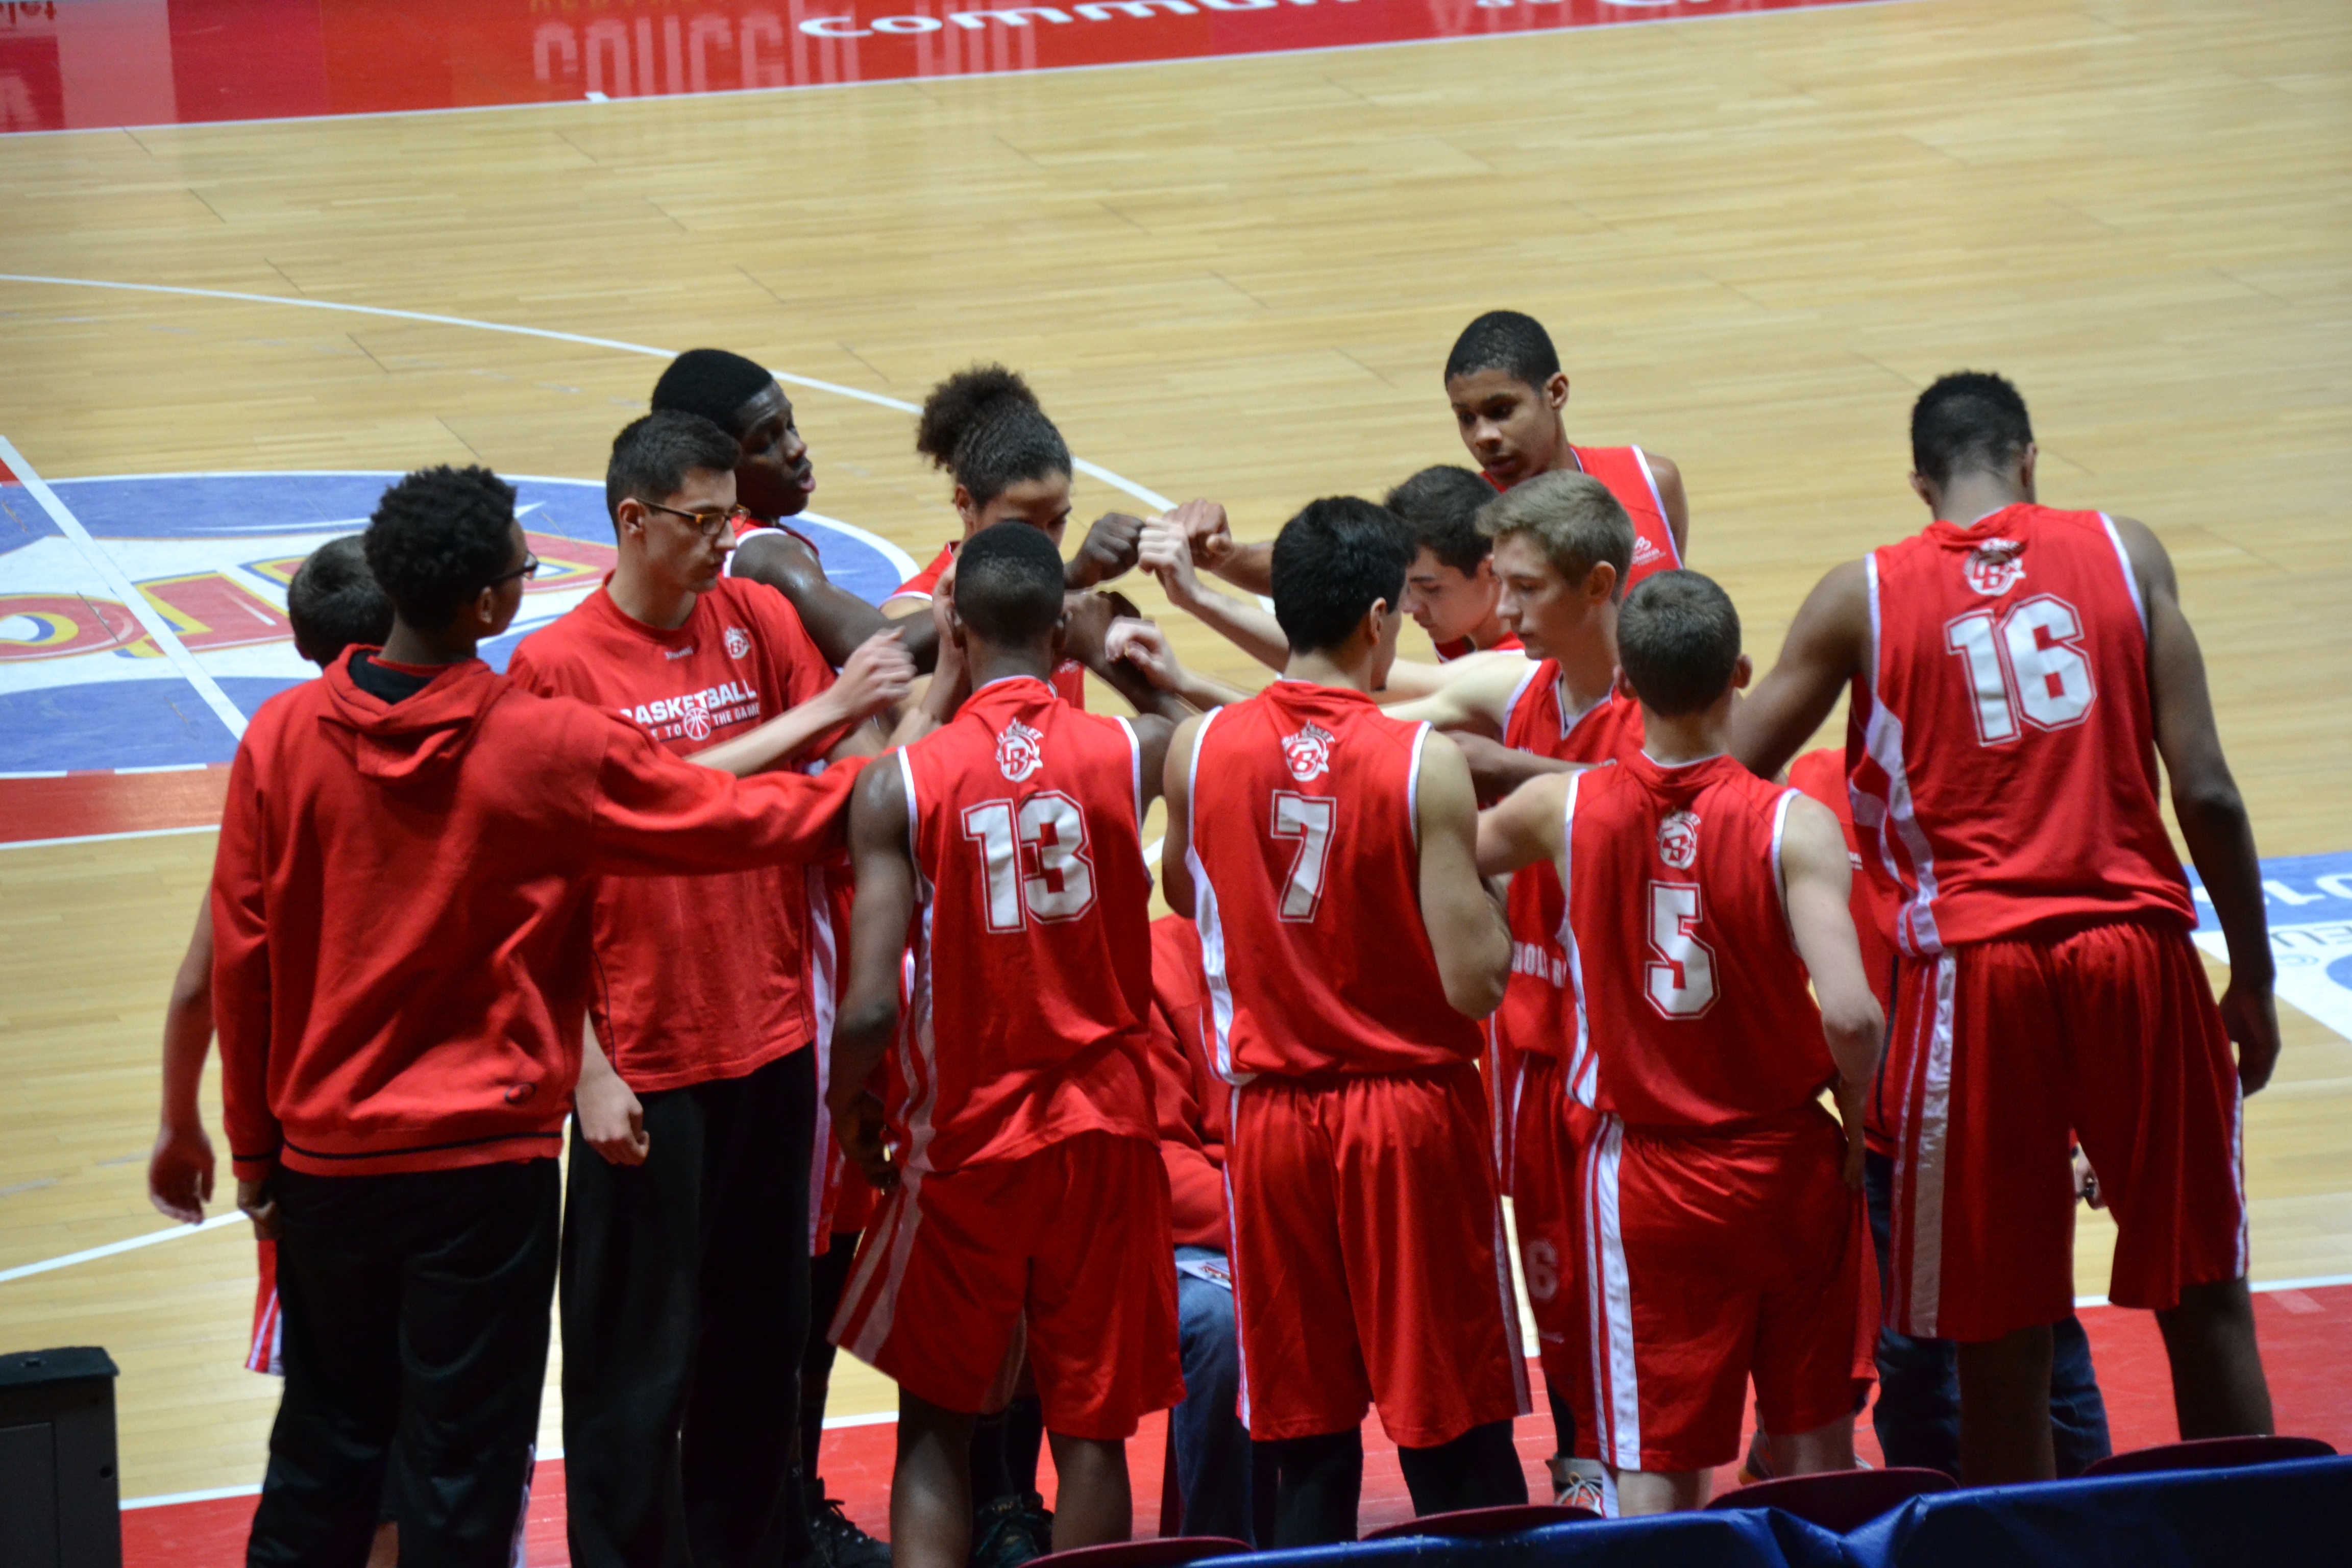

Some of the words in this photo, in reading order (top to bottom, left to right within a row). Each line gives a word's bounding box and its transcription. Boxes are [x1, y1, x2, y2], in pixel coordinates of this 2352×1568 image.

[665, 723, 682, 738] TO
[712, 710, 733, 726] THE
[1944, 593, 2097, 747] 16
[961, 790, 1097, 934] 13
[1270, 789, 1336, 923] 7
[1644, 879, 1720, 1020] 5
